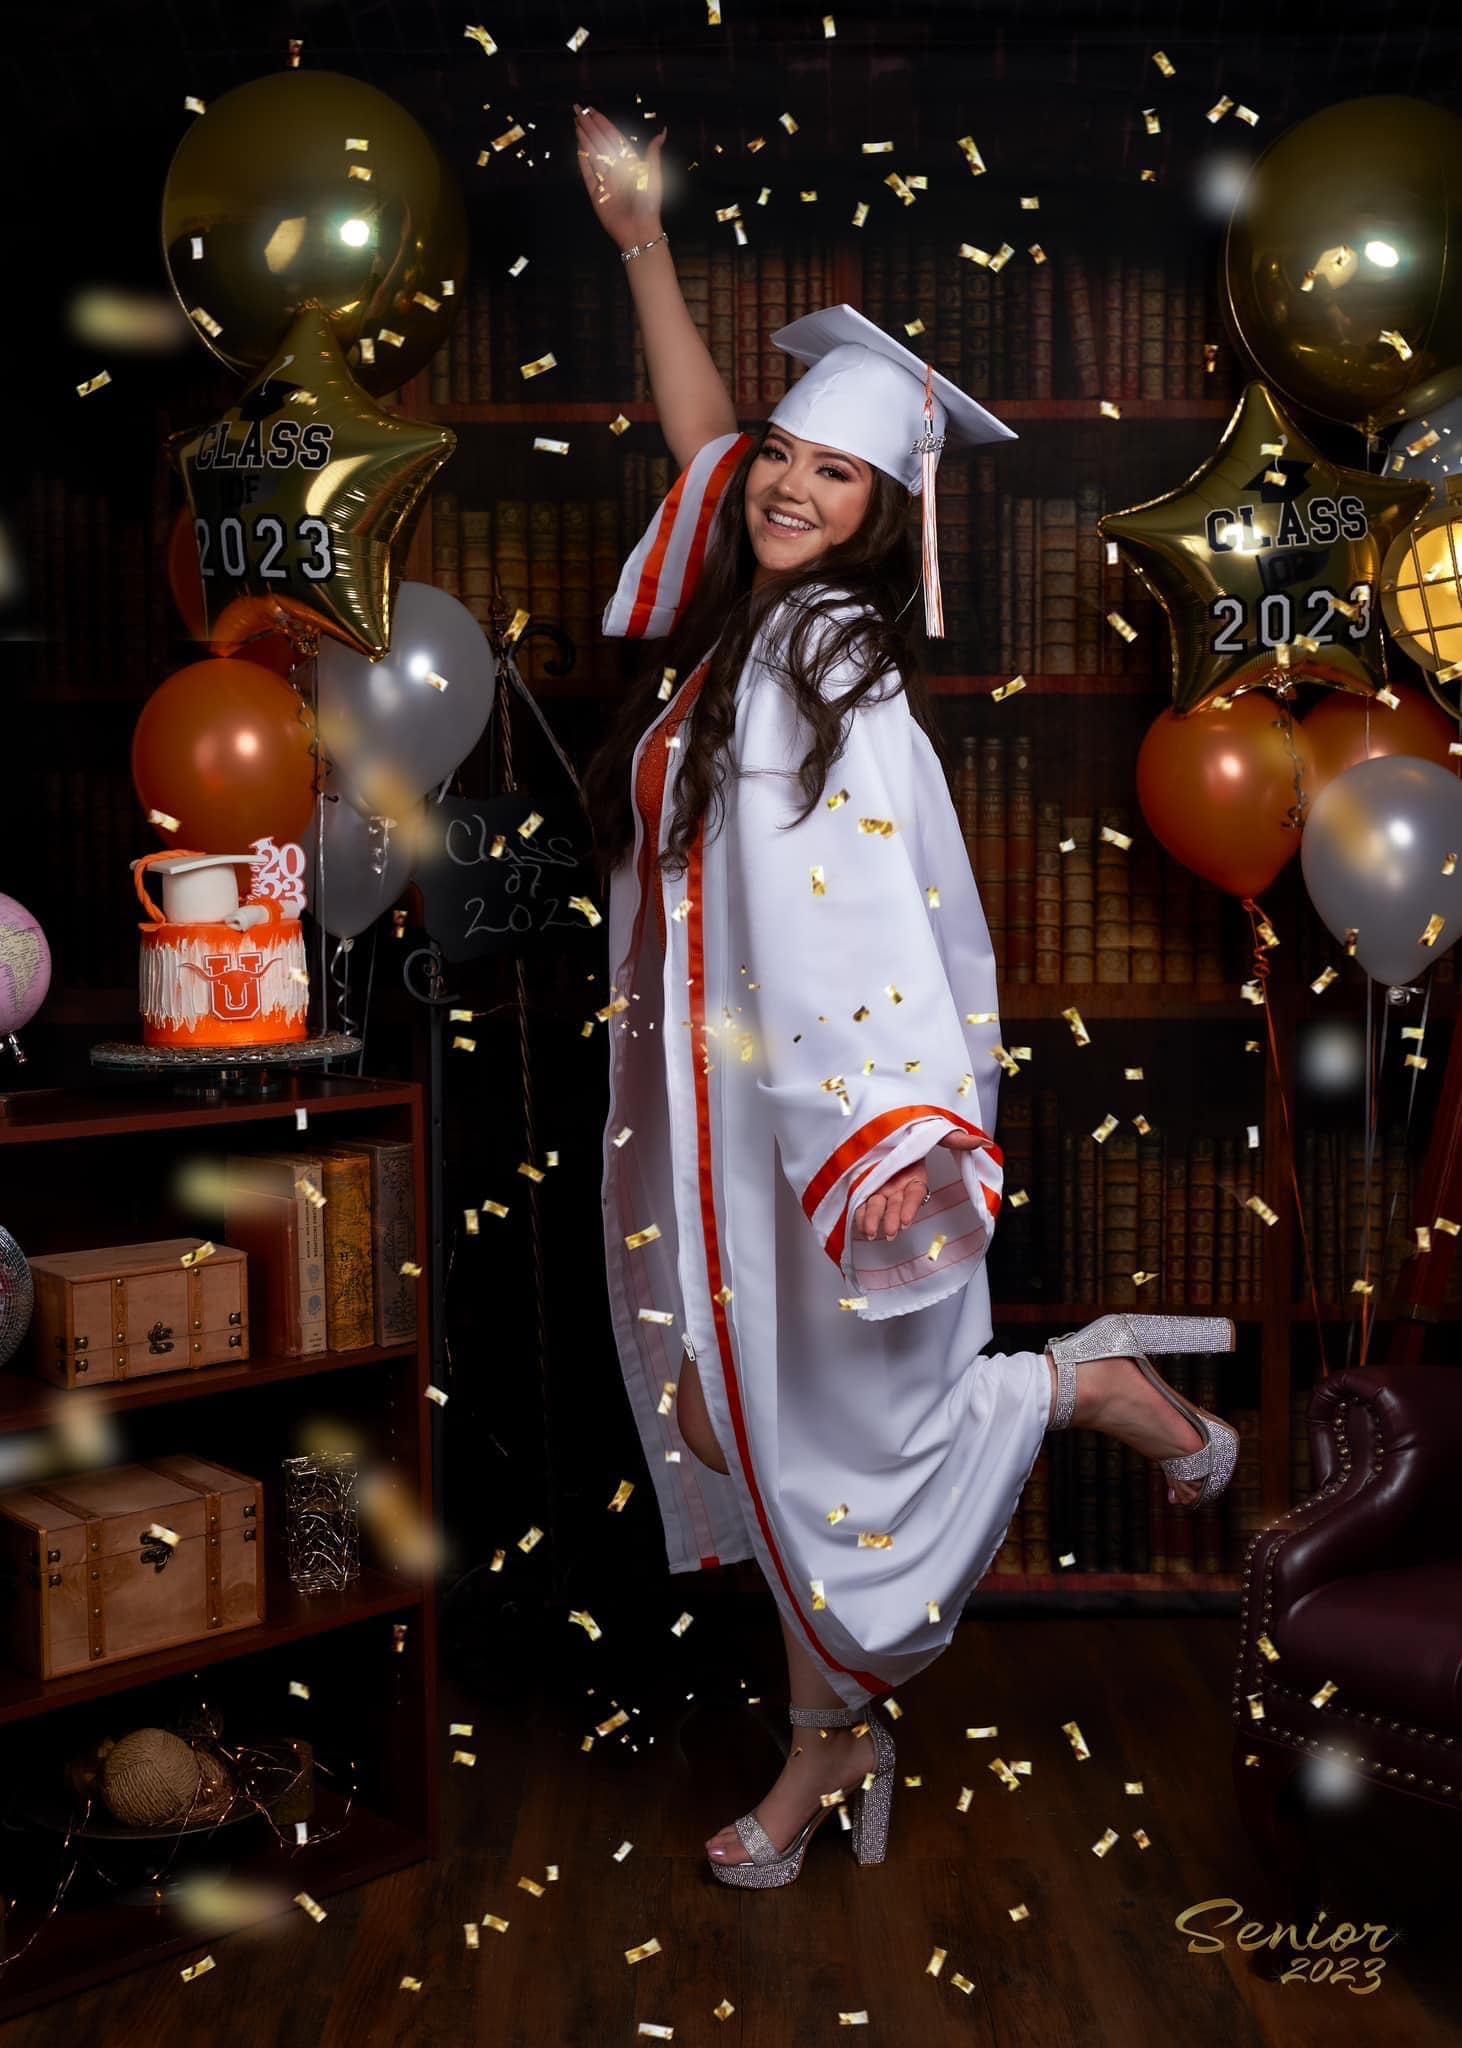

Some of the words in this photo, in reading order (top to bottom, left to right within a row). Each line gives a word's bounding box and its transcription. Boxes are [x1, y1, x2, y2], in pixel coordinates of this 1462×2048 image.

[194, 420, 334, 470] CLASS
[194, 516, 333, 579] 2023
[1205, 496, 1368, 552] CLASS
[1212, 583, 1373, 652] 2023
[505, 862, 542, 898] of
[463, 896, 600, 938] 202
